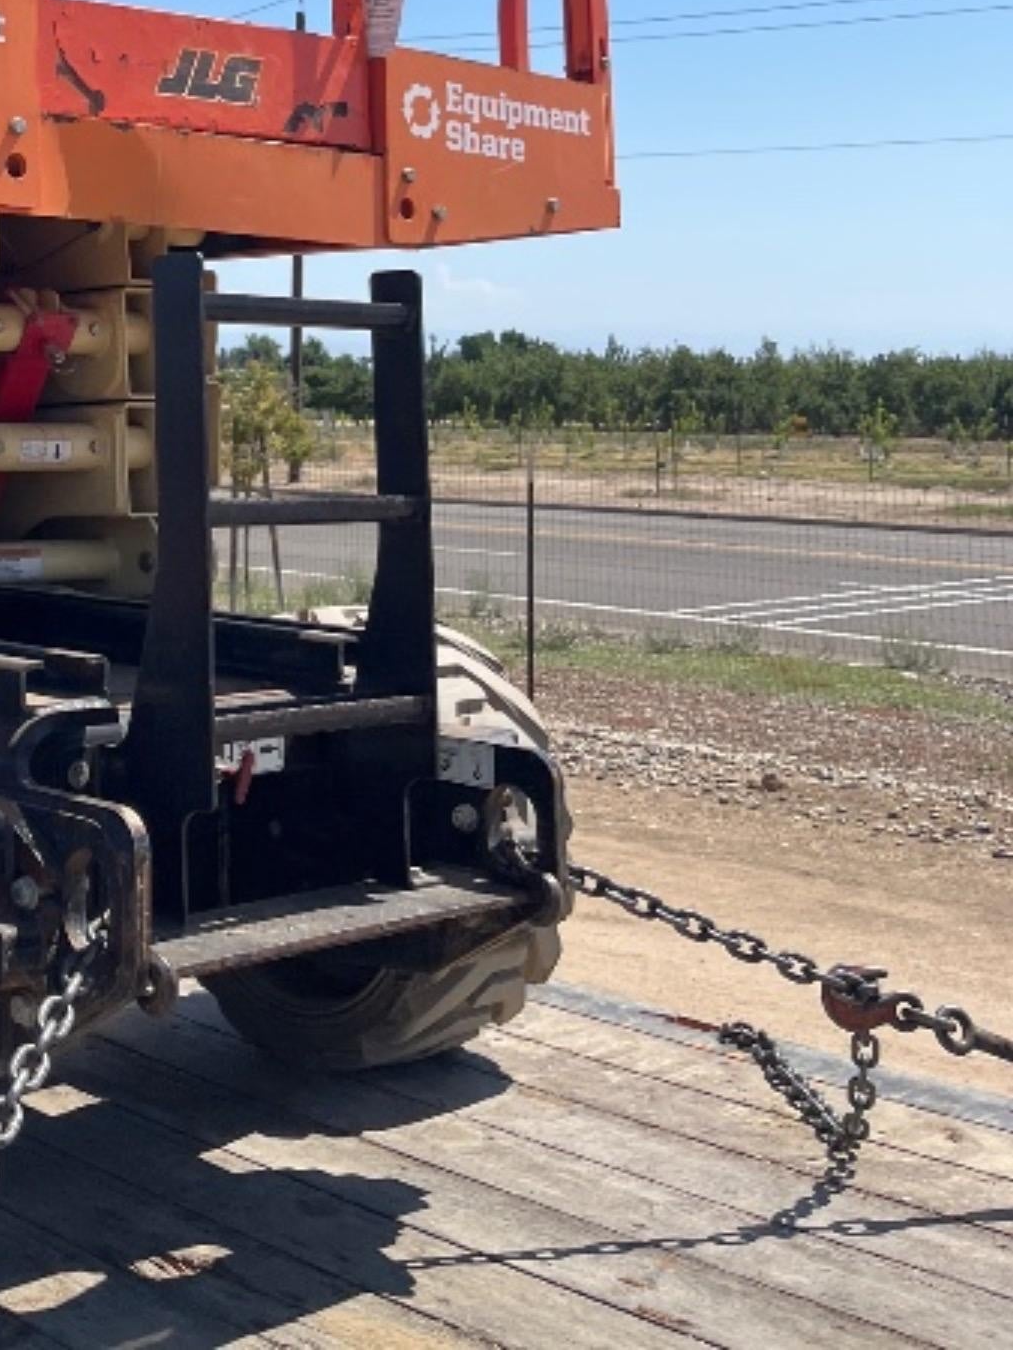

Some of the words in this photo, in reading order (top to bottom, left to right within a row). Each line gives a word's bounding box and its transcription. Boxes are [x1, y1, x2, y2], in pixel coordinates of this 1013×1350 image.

[155, 46, 264, 106] JLG
[445, 80, 591, 137] Equipment
[445, 119, 525, 163] Share
